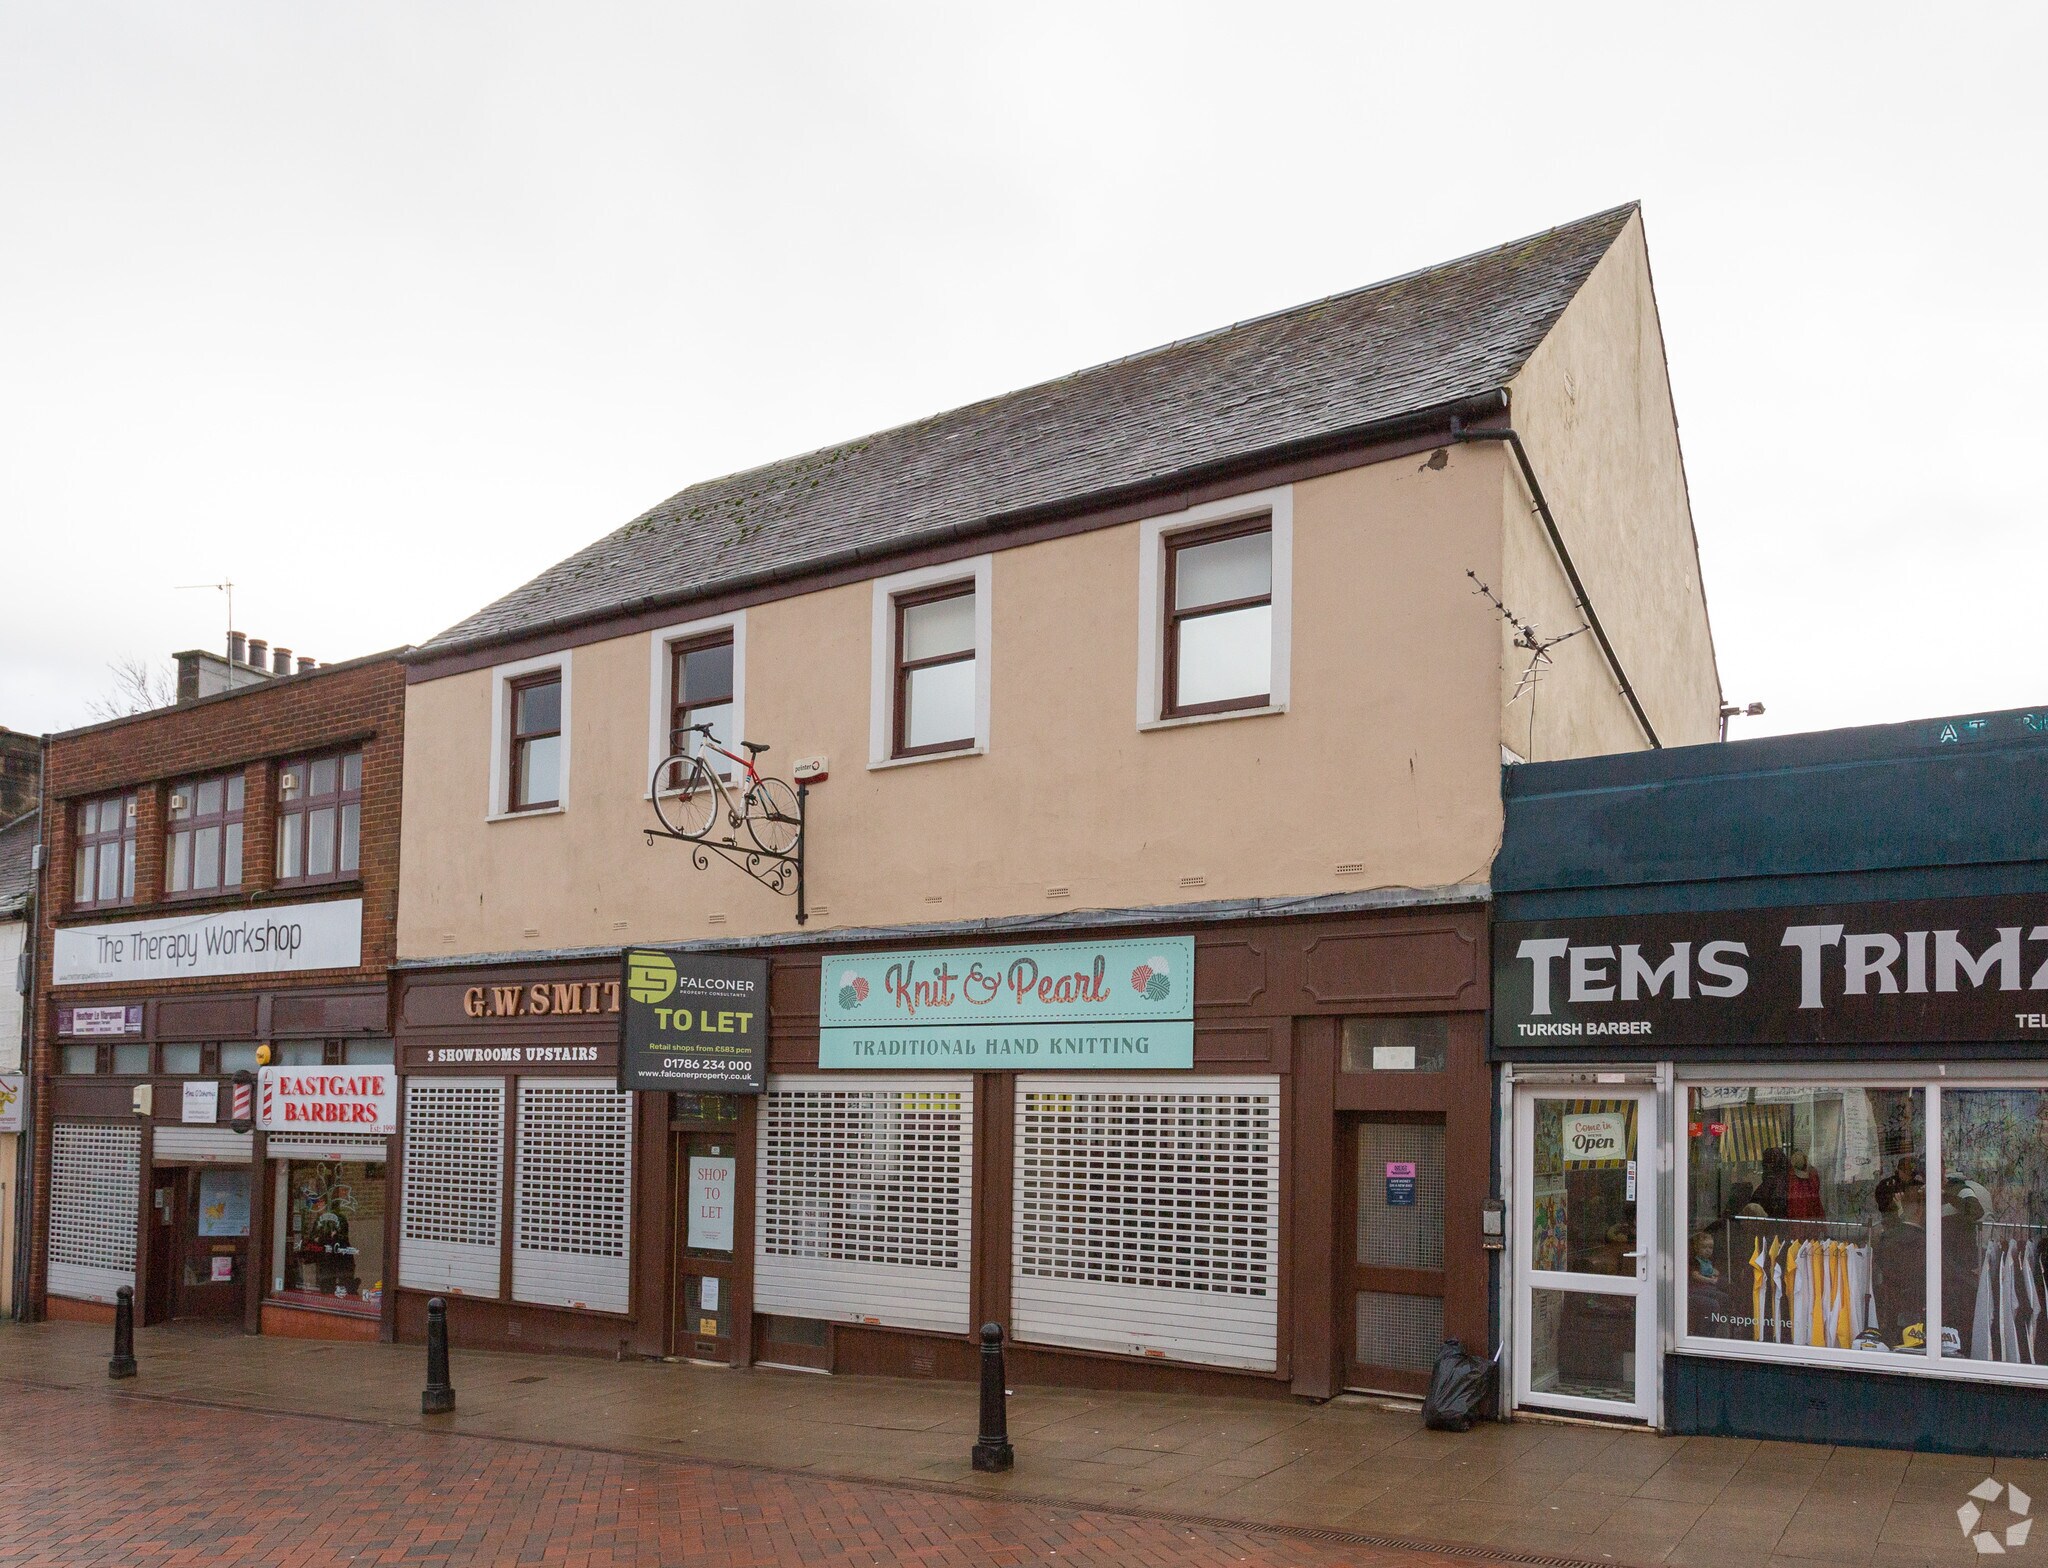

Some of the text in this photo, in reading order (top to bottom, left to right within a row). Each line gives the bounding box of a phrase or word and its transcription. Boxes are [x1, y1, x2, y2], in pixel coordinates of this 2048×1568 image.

[97, 918, 301, 967] The Therapy Workshop
[1516, 938, 1750, 1015] TEMS
[680, 977, 755, 991] FALCONER
[885, 954, 1111, 1015] Knit & Pearl
[654, 1008, 754, 1034] TO LET
[1517, 1021, 1652, 1036] TURKISH BARBER
[649, 1043, 671, 1051] Retail
[672, 1044, 695, 1053] shops
[696, 1045, 714, 1053] from
[853, 1036, 1150, 1056] TRADITIONAL HAND KNITTING
[427, 1046, 598, 1062] 3 SHOWROOMS UPSTAIRS
[663, 1058, 752, 1071] 01786 234 000
[638, 1070, 752, 1081] www.falconerproperty.co.uk
[279, 1076, 385, 1097] EASTGATE
[284, 1102, 378, 1123] BARBERS
[383, 1124, 396, 1133] 1999
[1575, 1122, 1601, 1133] Come
[1572, 1134, 1615, 1154] Open
[698, 1168, 727, 1181] SHOP
[705, 1187, 720, 1200] TO
[701, 1205, 722, 1219] LET
[1711, 1312, 1728, 1323] No
